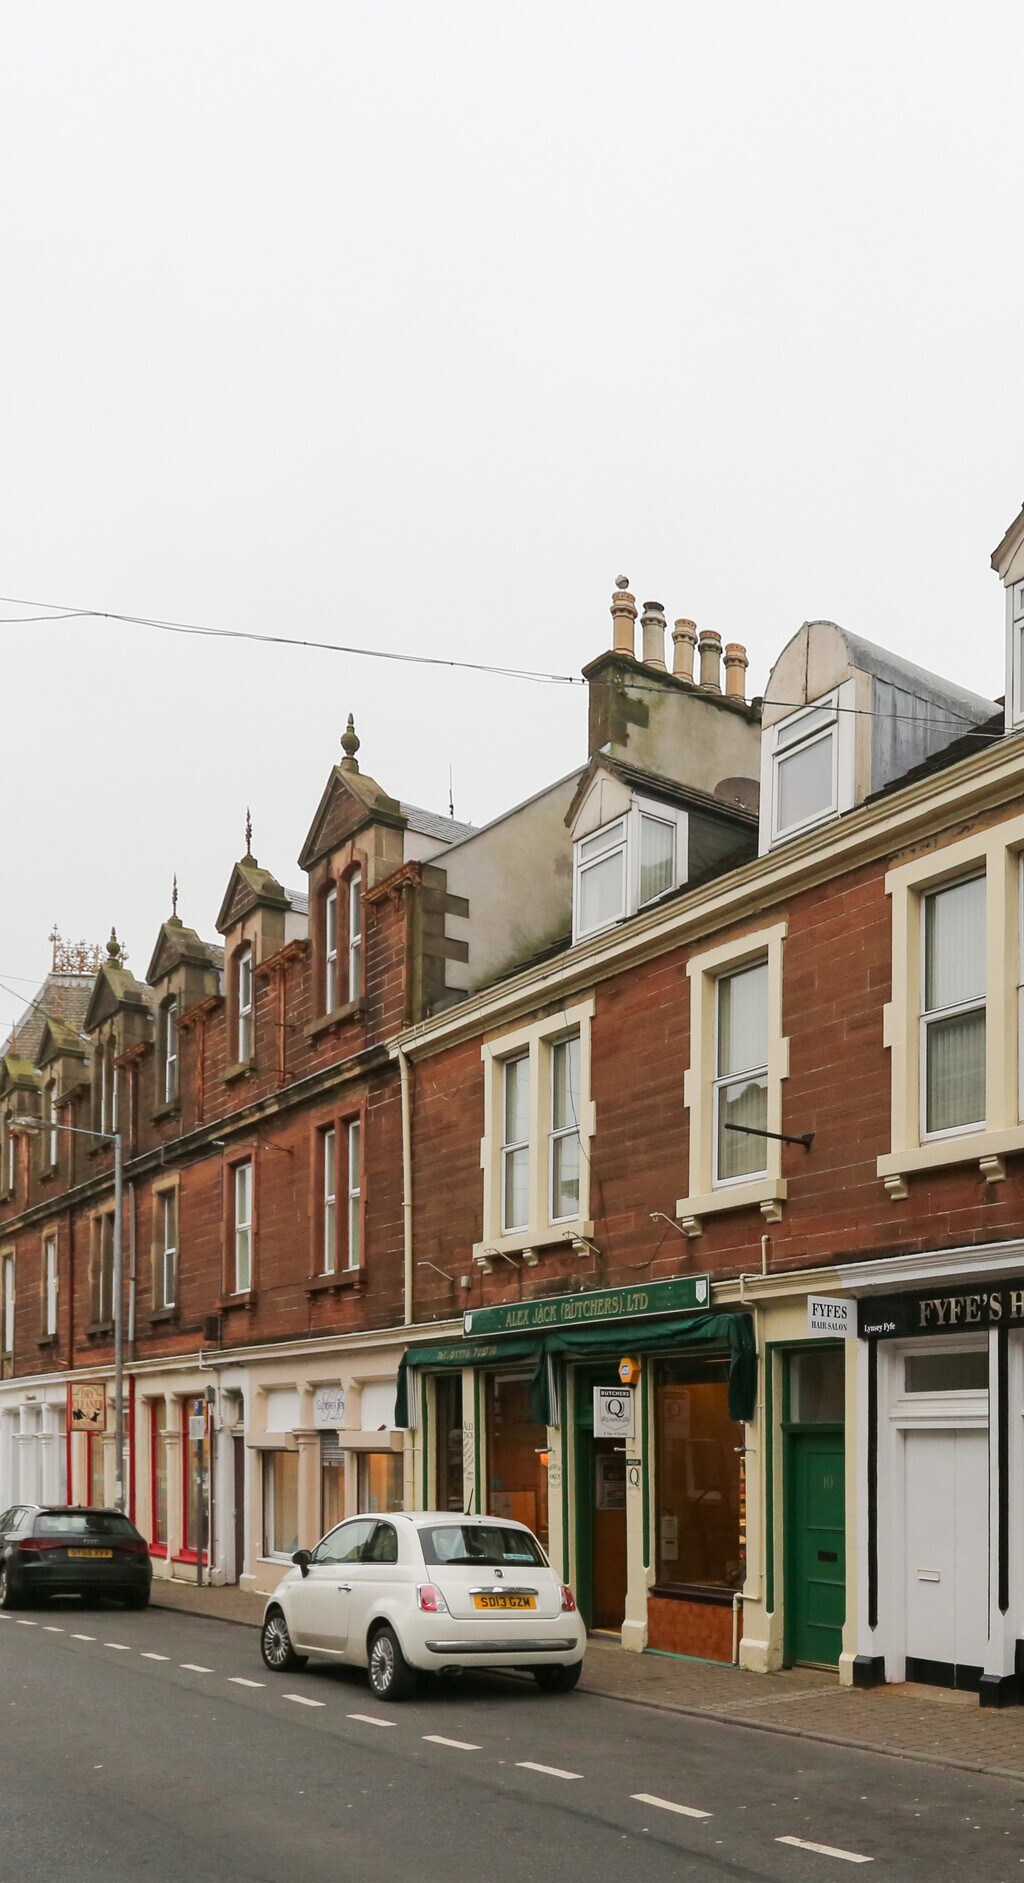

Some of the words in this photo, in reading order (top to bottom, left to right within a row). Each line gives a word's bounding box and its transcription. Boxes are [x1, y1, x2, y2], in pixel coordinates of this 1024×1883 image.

[505, 1309, 530, 1328] ALEX
[532, 1304, 557, 1324] JACK
[560, 1293, 623, 1321] (BUTCHERS)
[626, 1292, 649, 1313] LTD
[812, 1302, 848, 1320] FYFES
[919, 1292, 1003, 1327] FYFE'S
[811, 1320, 827, 1330] HAIR
[827, 1322, 848, 1331] SALON
[864, 1324, 883, 1334] Lynsey
[883, 1321, 896, 1332] Fyfe
[81, 1389, 94, 1400] DRY
[607, 1398, 625, 1418] Q
[480, 1597, 507, 1608] SD13
[509, 1597, 531, 1608] GZM
